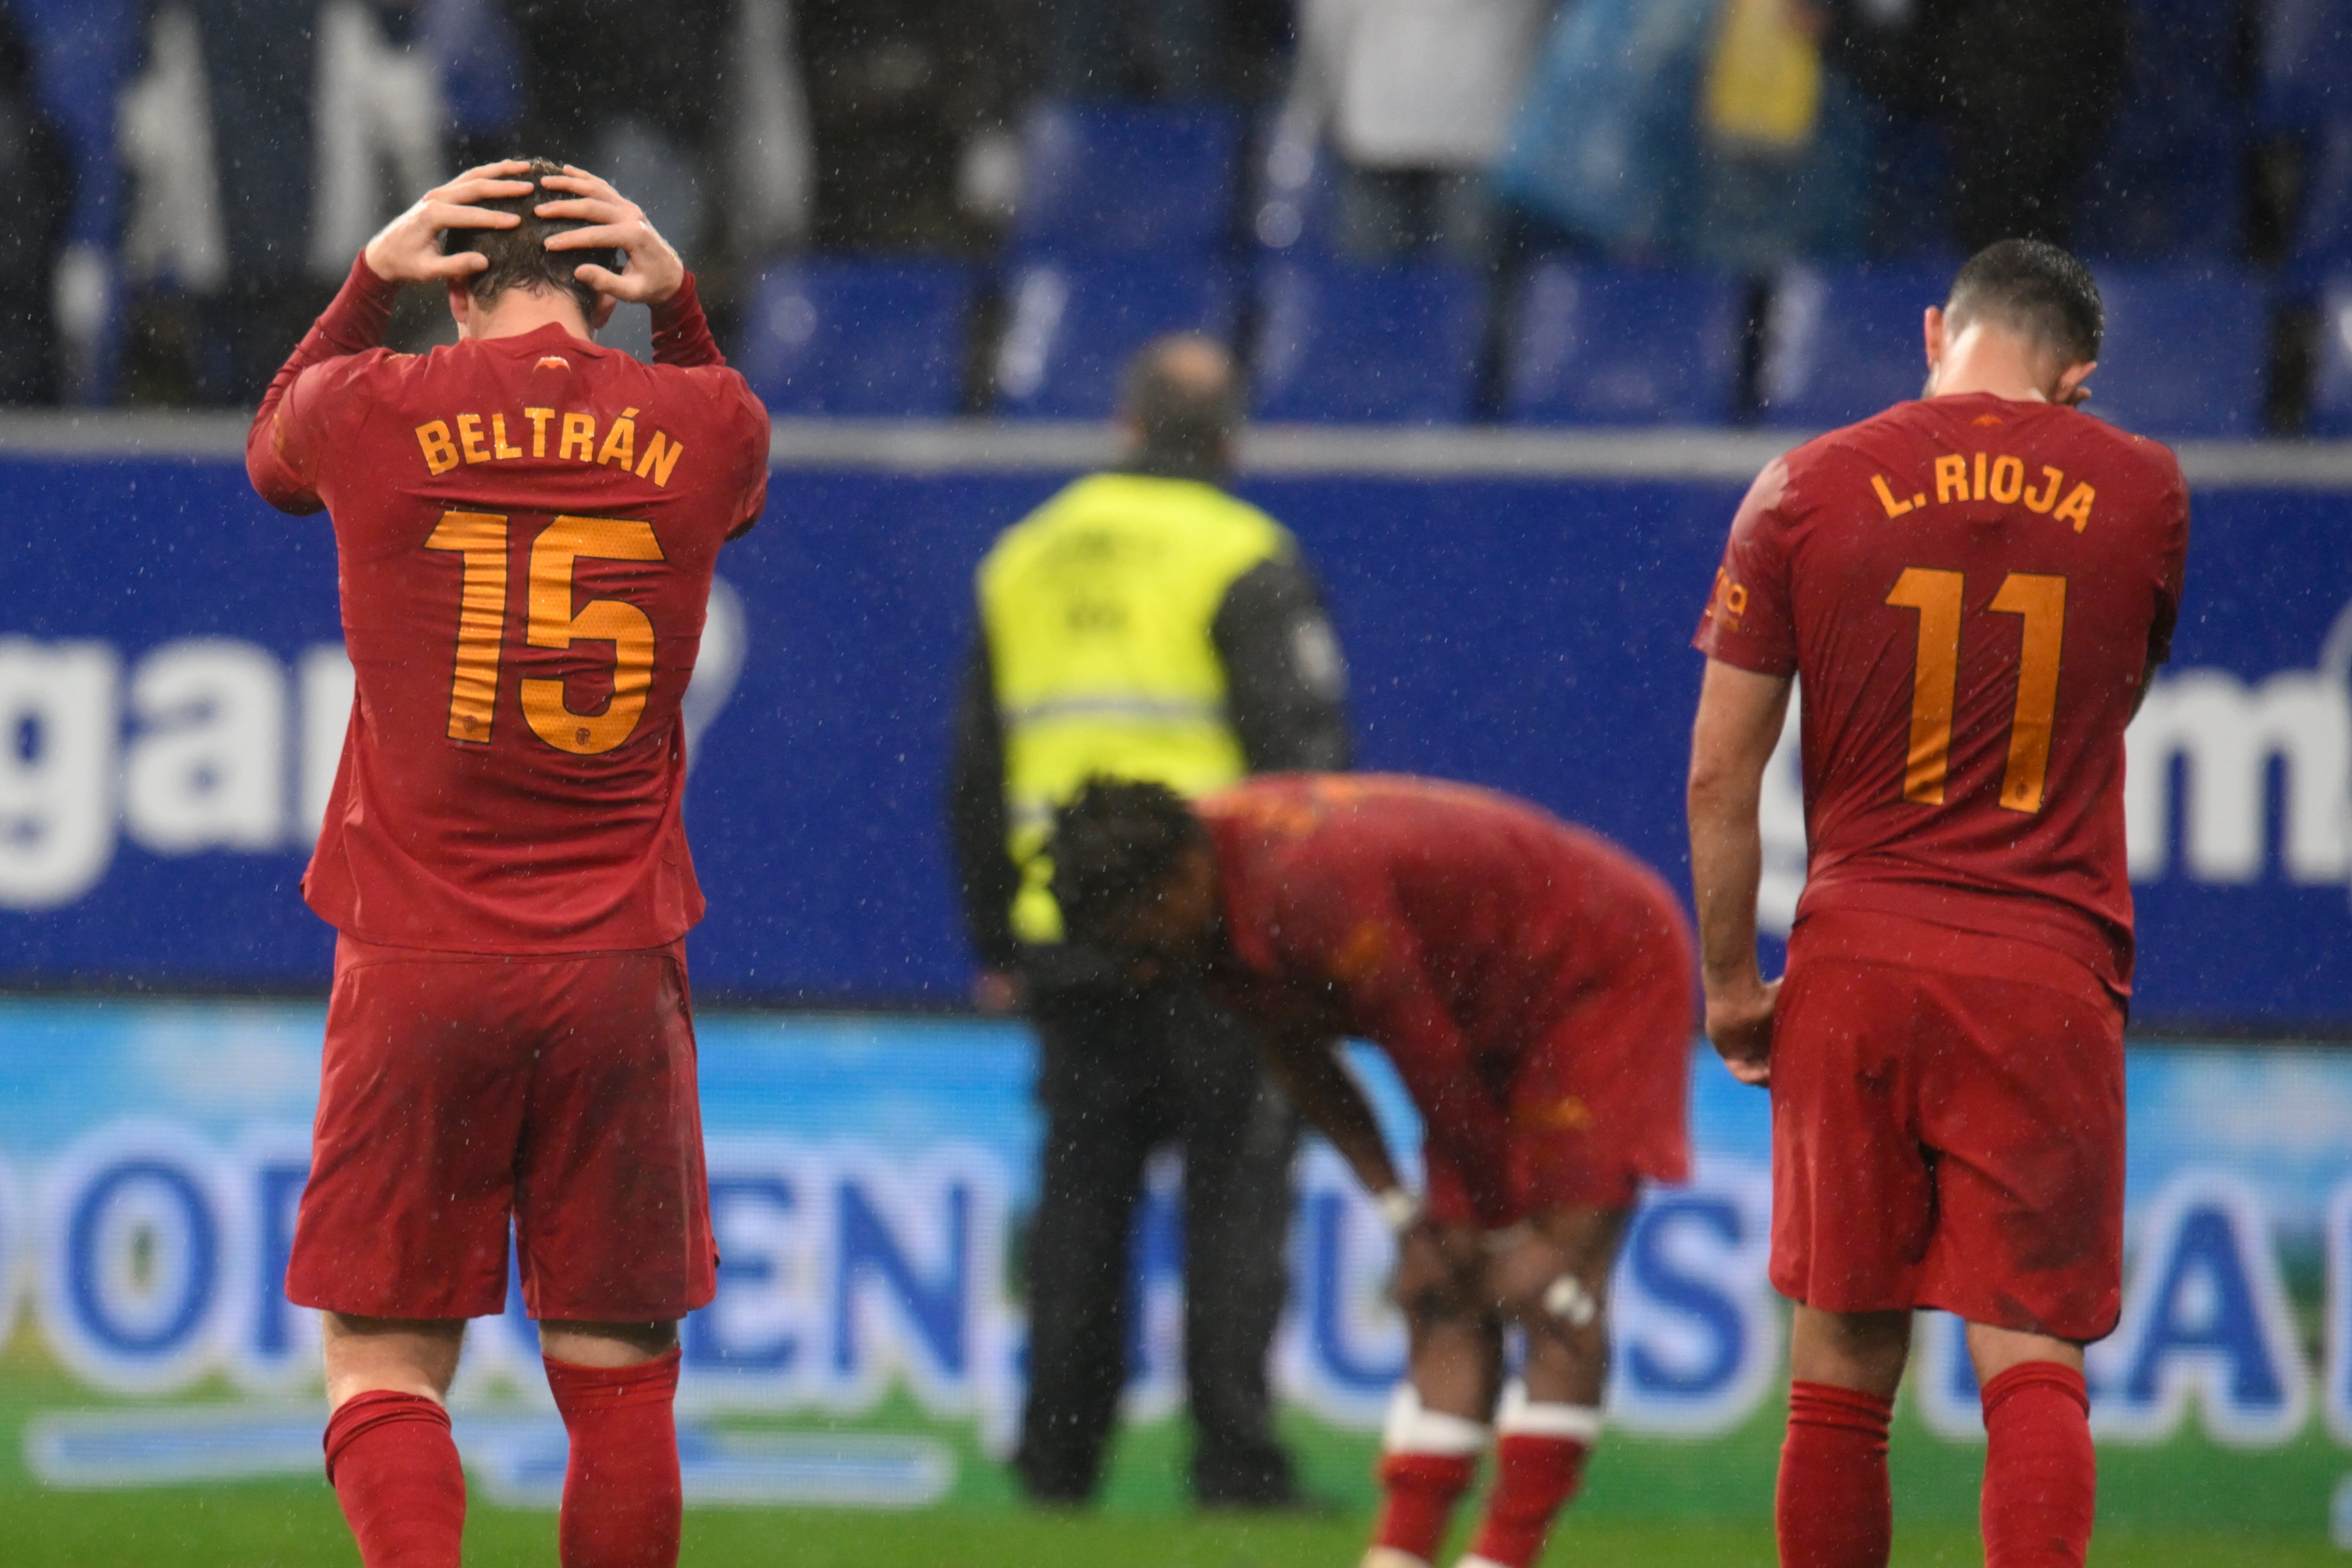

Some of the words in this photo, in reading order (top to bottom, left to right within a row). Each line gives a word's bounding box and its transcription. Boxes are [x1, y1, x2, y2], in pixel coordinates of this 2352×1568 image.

[415, 406, 684, 488] BELTRÁN
[422, 509, 666, 755] 15
[1884, 566, 2067, 814] 11
